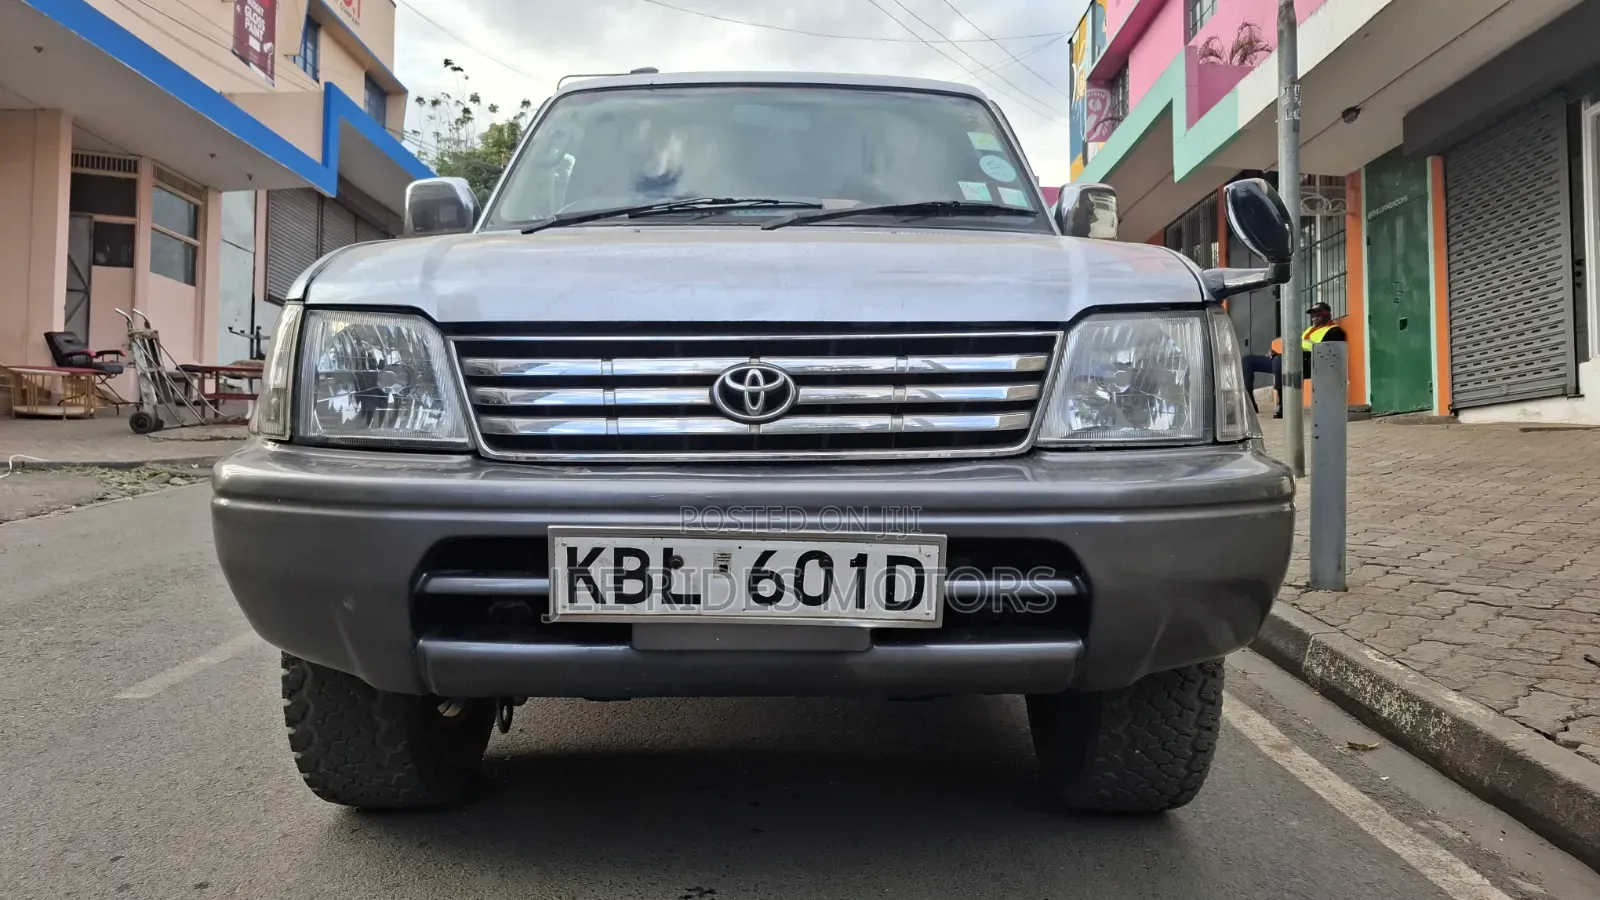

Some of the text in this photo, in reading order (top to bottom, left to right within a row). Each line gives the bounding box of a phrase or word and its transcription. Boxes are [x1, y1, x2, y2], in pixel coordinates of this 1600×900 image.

[245, 5, 265, 32] GLOSS
[245, 17, 265, 41] PAINT
[566, 547, 926, 612] KBL 601D
